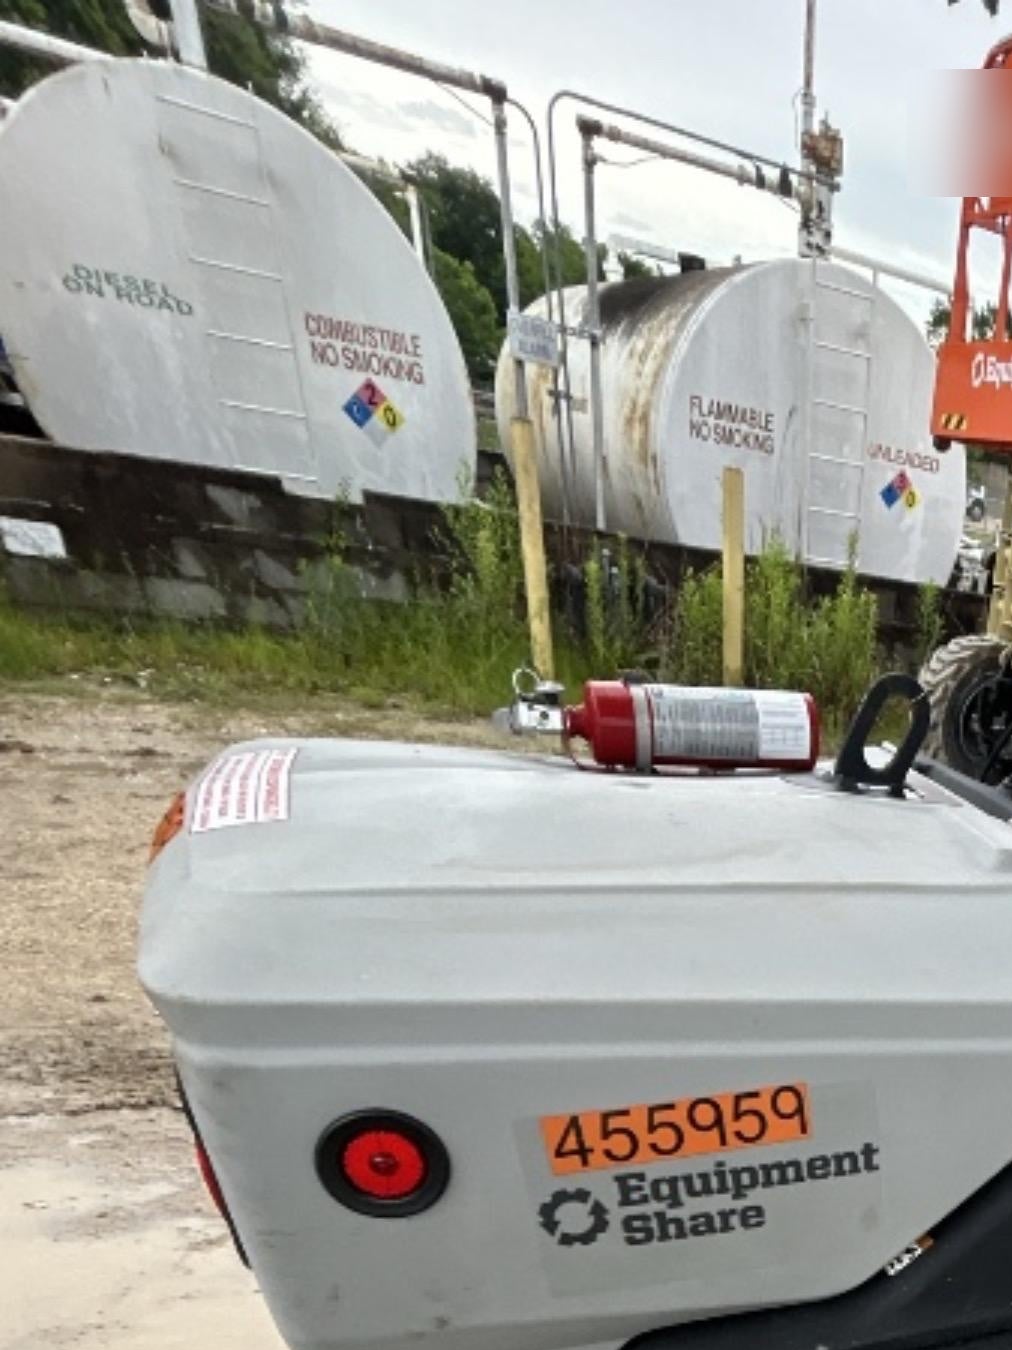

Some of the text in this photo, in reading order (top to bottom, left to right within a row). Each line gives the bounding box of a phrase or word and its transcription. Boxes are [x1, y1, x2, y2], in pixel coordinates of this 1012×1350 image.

[304, 312, 422, 357] COMBUSTIBLE
[310, 341, 424, 384] NO SMOKING
[365, 382, 379, 406] 2
[689, 395, 774, 432] FLAMMABLE
[689, 419, 774, 455] NO SMOKING
[554, 1085, 808, 1168] 455959
[613, 1142, 880, 1209] Equipment
[621, 1203, 766, 1246] Share
